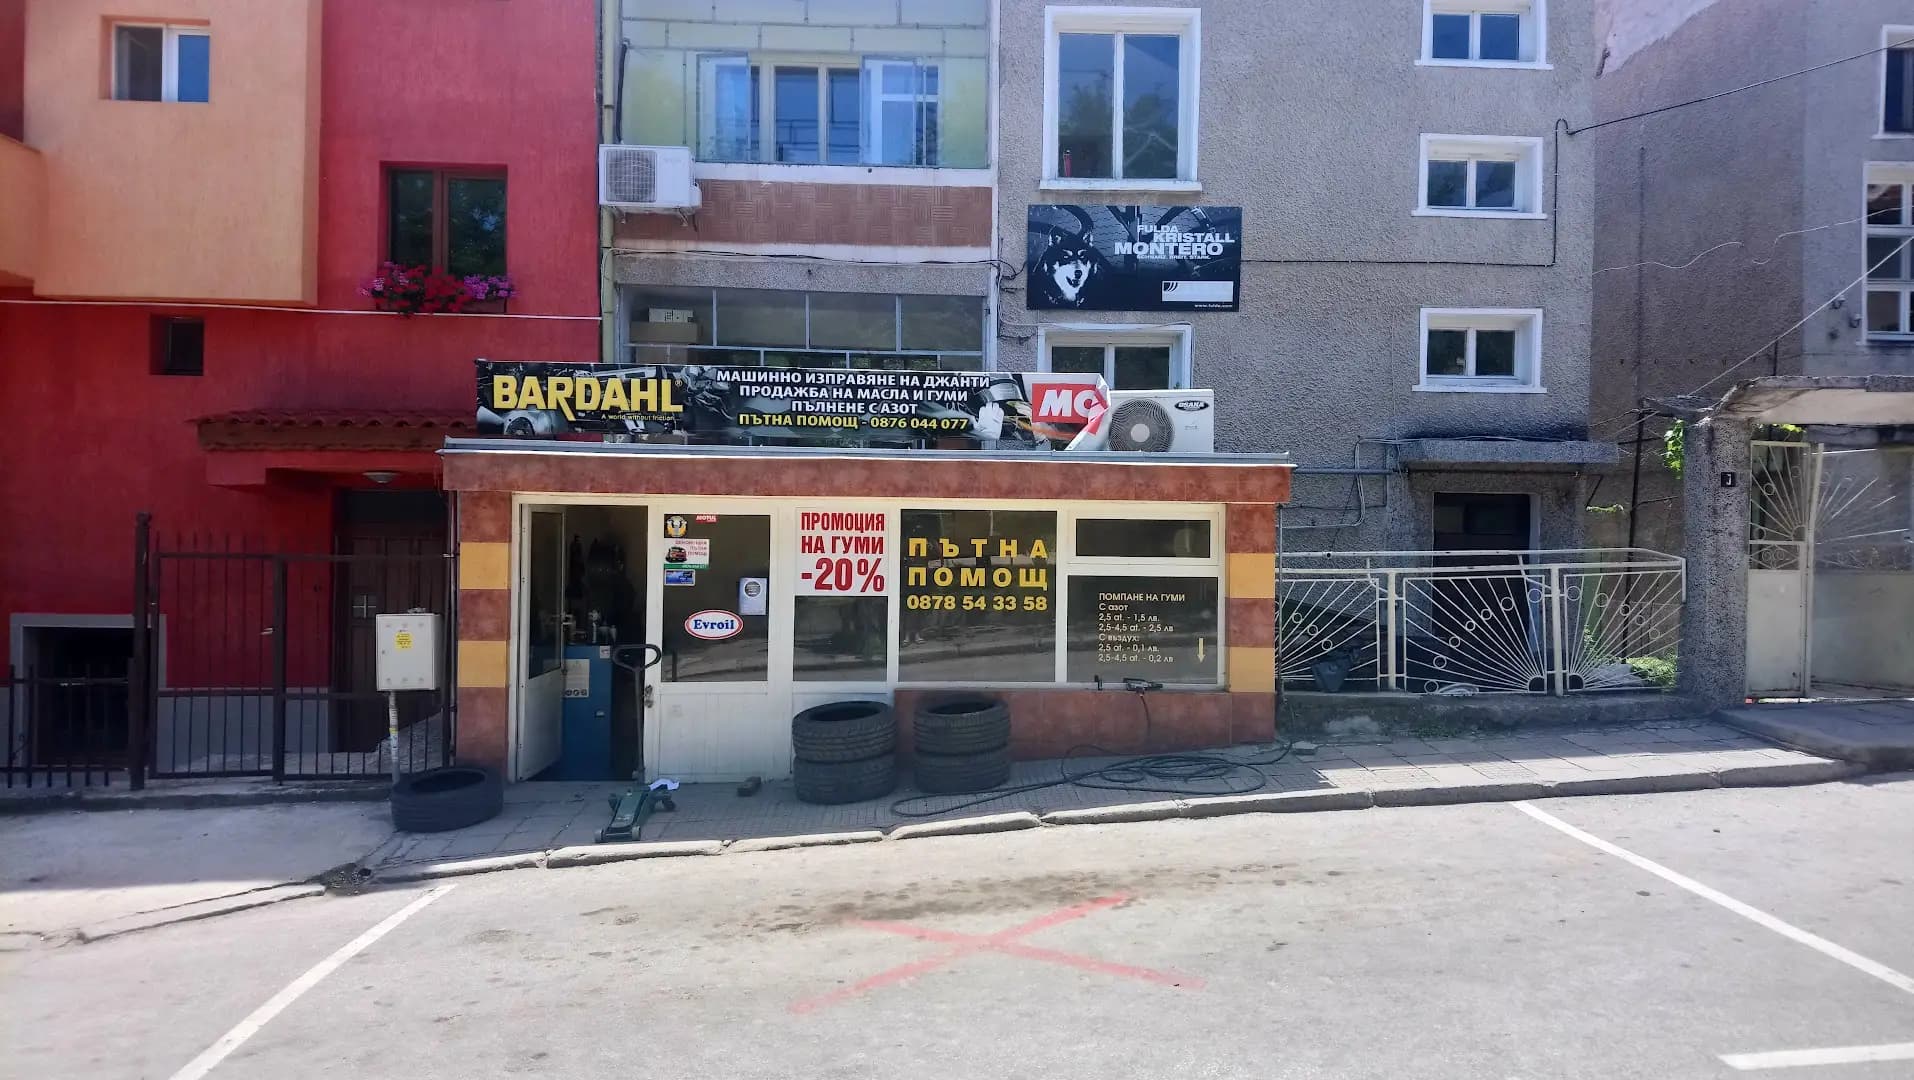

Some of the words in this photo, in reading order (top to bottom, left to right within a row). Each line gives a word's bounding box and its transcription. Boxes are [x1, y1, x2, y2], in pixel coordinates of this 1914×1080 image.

[1137, 225, 1179, 233] FULDA
[1154, 233, 1235, 243] KRISTALL
[1114, 242, 1224, 256] MONTERO
[716, 370, 801, 383] МАШИННО
[805, 373, 896, 386] ИЗПРАВЯНЕ
[900, 375, 920, 387] НА
[923, 376, 990, 388] ДЖАНТИ
[493, 375, 684, 421] BARDAHL
[739, 385, 829, 399] ПРОДАЖБА
[833, 388, 853, 399] НА
[857, 389, 909, 400] МАСЛА
[913, 390, 923, 401] И
[927, 390, 968, 402] ГУМИ
[791, 401, 865, 413] ПЪЛНЕНЕ
[868, 402, 877, 413] С
[880, 403, 918, 415] АЗОТ
[739, 413, 792, 426] ПЪТНА
[796, 415, 858, 429] ПОМОЩ
[870, 417, 907, 428] 0876
[910, 418, 938, 429] 044
[941, 419, 968, 429] 077
[801, 512, 885, 533] ПРОМОЦИЯ
[801, 535, 825, 553] НА
[831, 535, 884, 554] ГУМИ
[907, 537, 1048, 559] ПЪТНА
[801, 557, 885, 592] -20%
[907, 567, 1048, 591] ПОМОЩ
[906, 595, 956, 611] 0878
[962, 595, 987, 611] 54
[993, 596, 1017, 611] 33
[1023, 596, 1048, 611] 58
[1099, 592, 1144, 601] ПОМПАНЕ
[1146, 593, 1159, 601] НА
[1161, 594, 1185, 602] ГУМИ
[1099, 603, 1106, 611] С
[693, 618, 735, 630] Evroil
[1098, 613, 1111, 622] 2,5
[1134, 613, 1146, 622] 1,5
[1098, 623, 1127, 632] 2,5-4,5
[1149, 624, 1161, 632] 2,5
[1098, 633, 1106, 641] С
[1098, 643, 1111, 652] 2,5
[1132, 644, 1145, 653] 0,1
[1098, 654, 1127, 663] 2,5-4,5
[1148, 655, 1161, 664] 0,2
